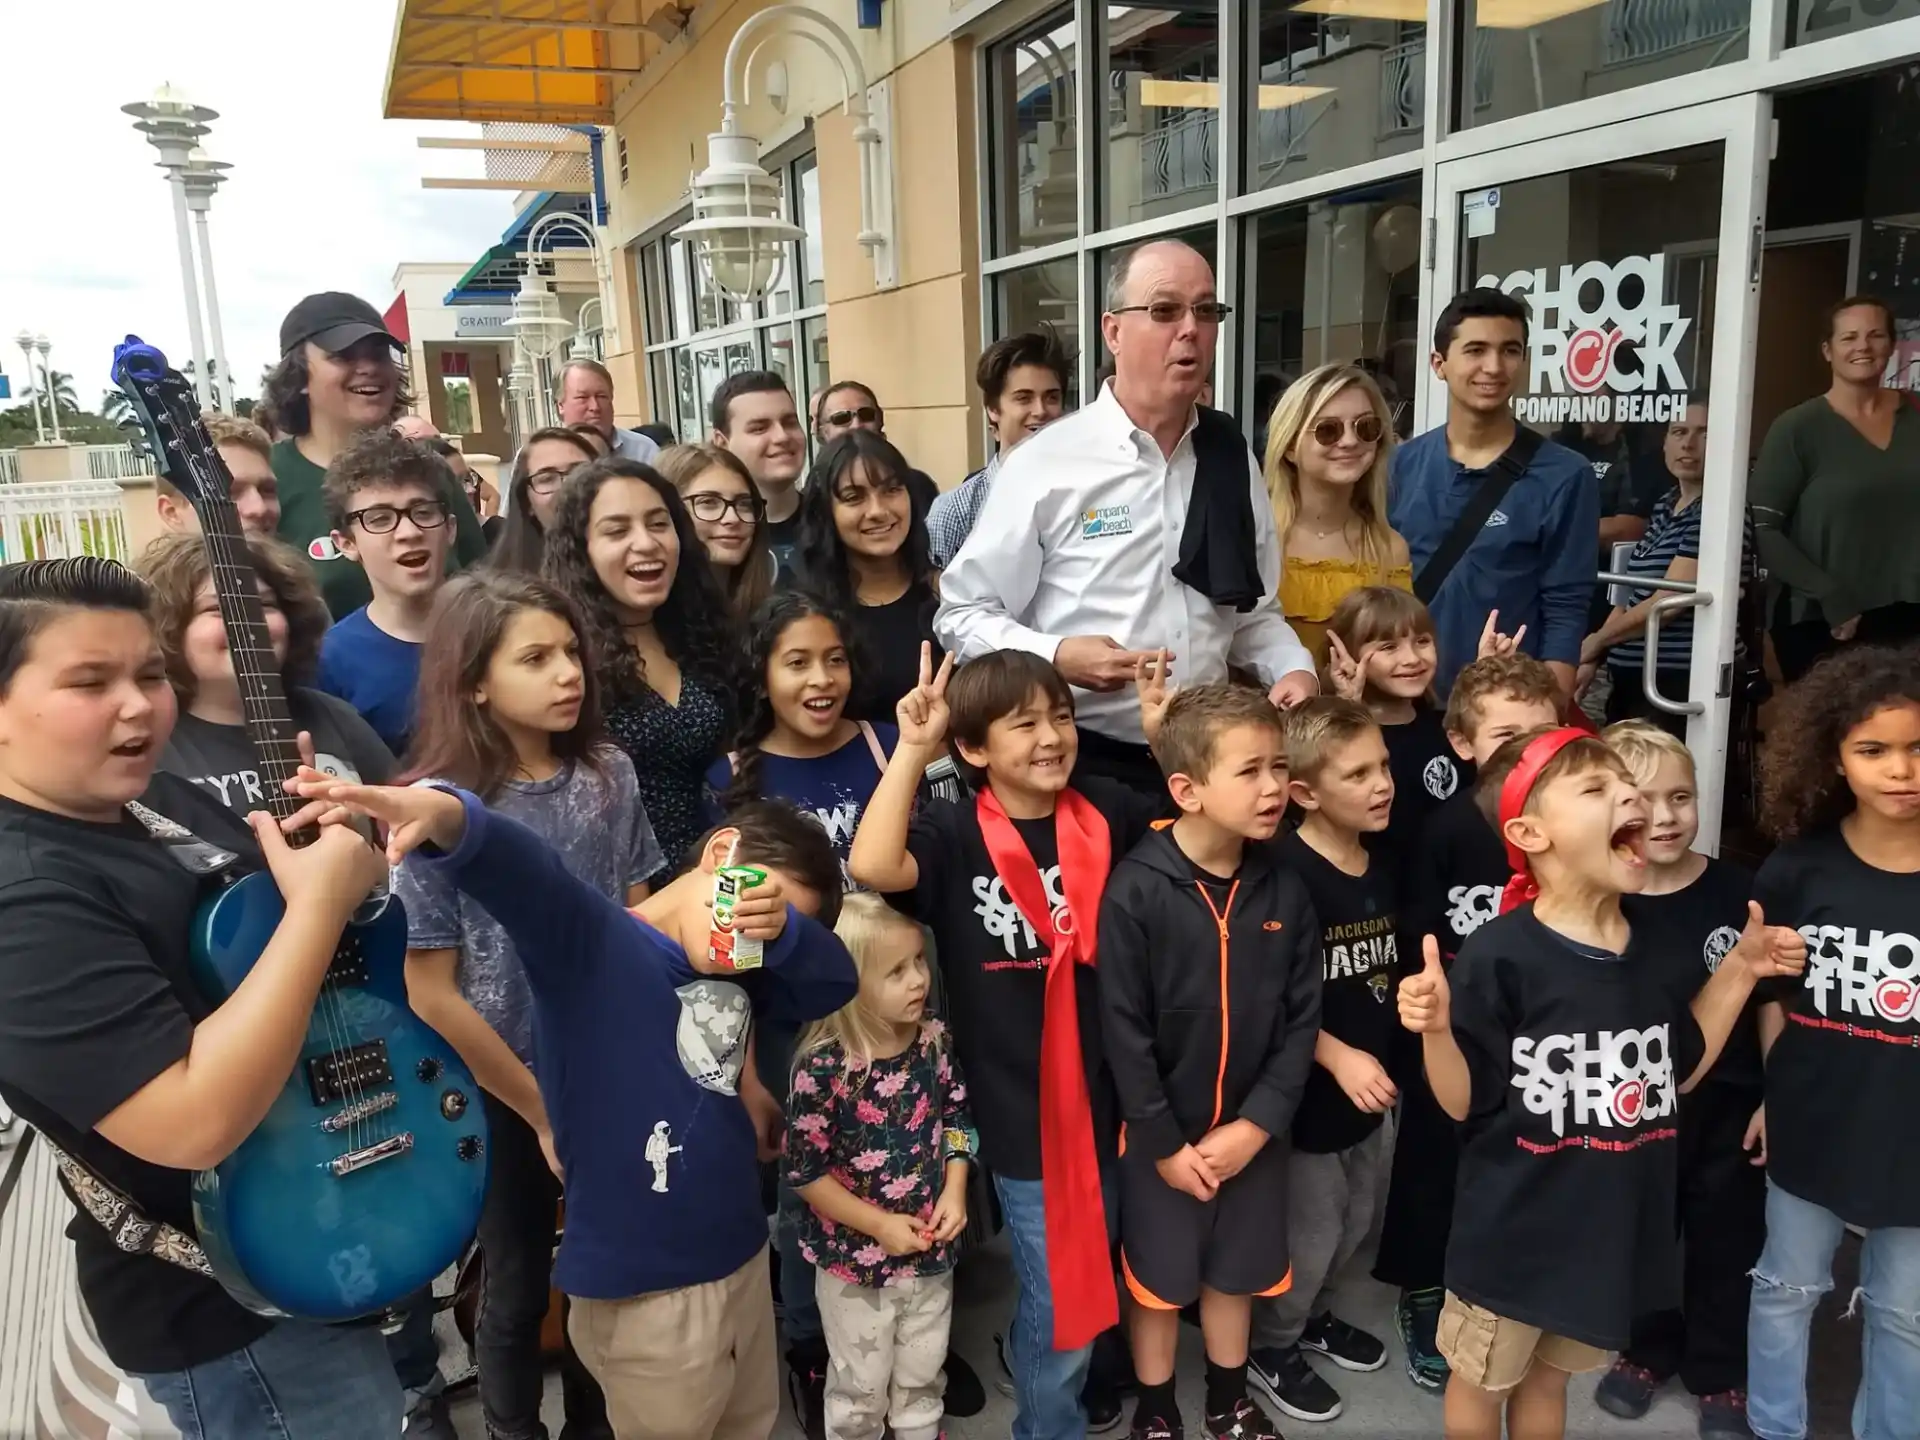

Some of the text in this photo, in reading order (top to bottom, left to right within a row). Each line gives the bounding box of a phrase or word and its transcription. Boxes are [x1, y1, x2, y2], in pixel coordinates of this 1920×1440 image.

[1515, 393, 1687, 423] POMPANO BEACH
[1102, 518, 1132, 533] beach
[1510, 1023, 1673, 1088] SCHOOL
